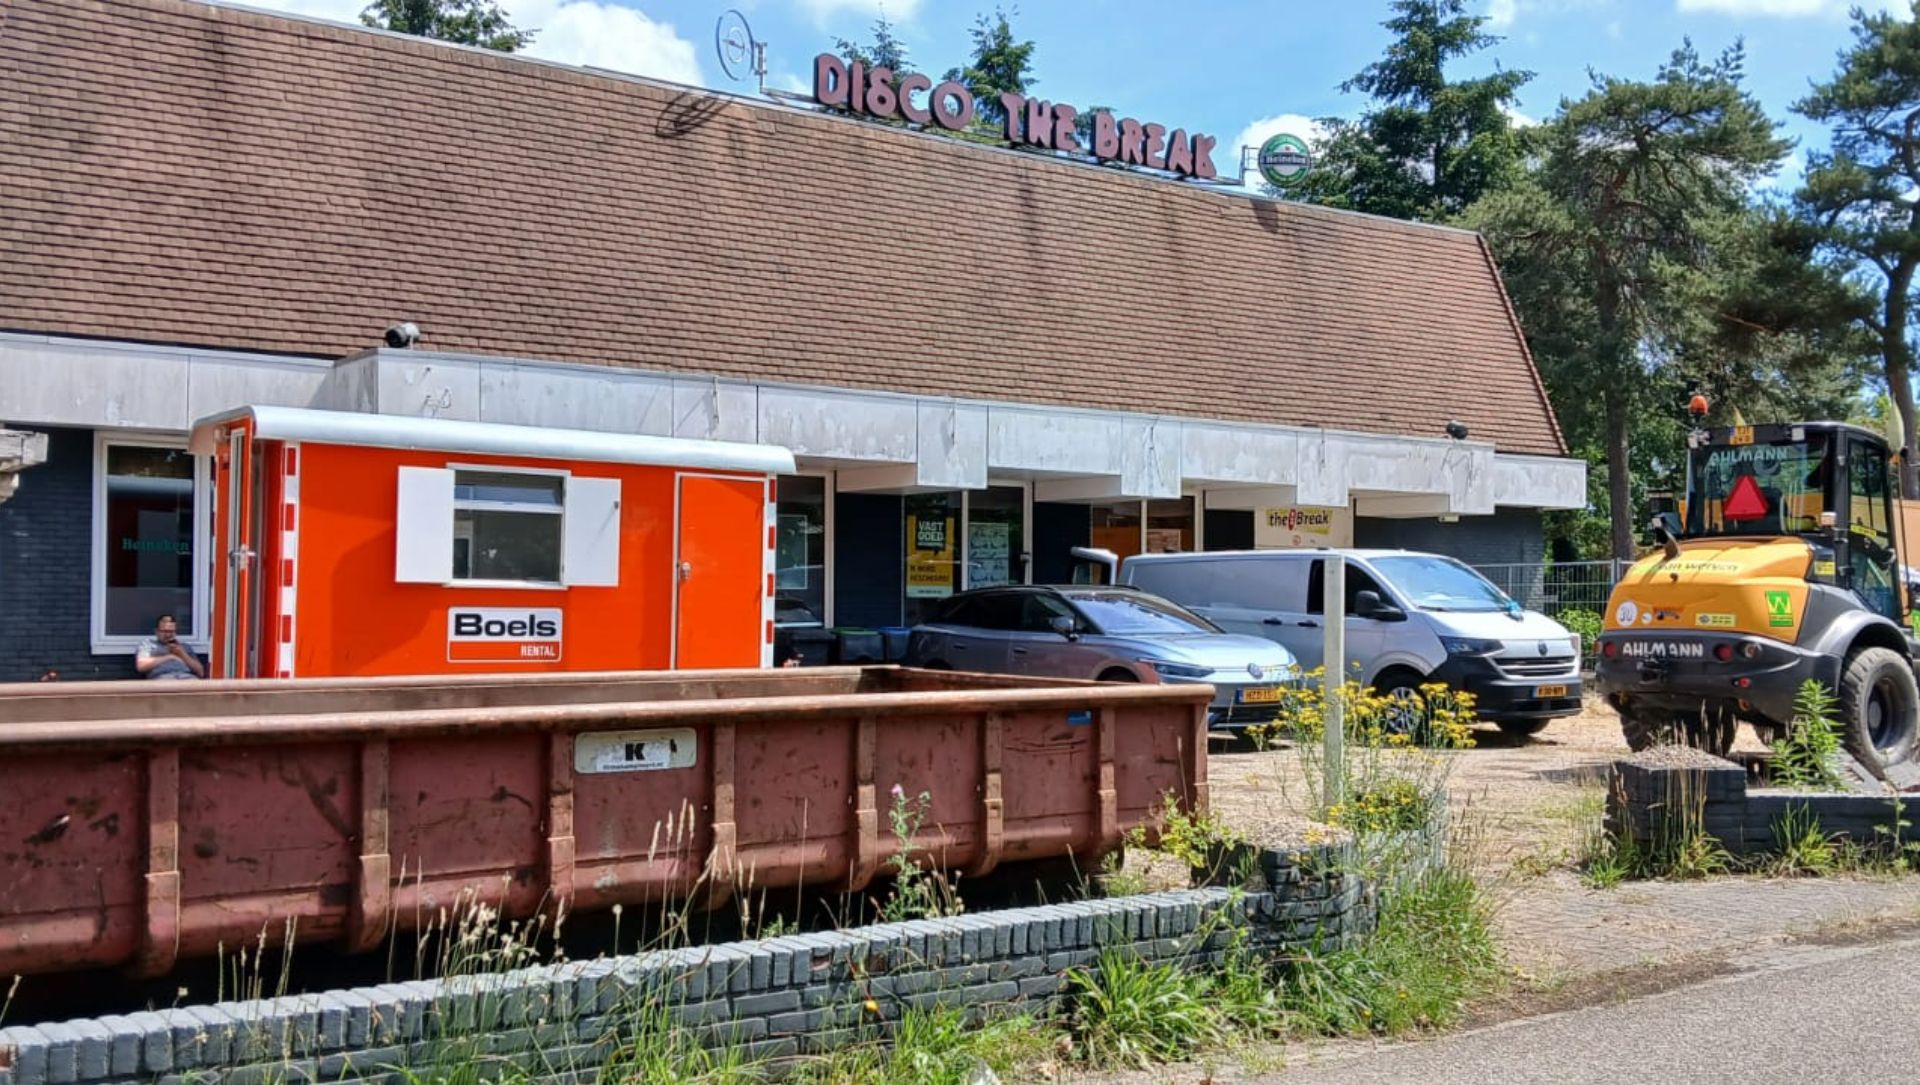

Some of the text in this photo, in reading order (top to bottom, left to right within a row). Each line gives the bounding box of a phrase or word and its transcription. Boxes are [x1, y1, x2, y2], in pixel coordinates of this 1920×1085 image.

[814, 53, 1217, 179] DISCO THE BREAK
[1705, 447, 1788, 465] AHLMANN
[1296, 509, 1329, 526] Break
[918, 521, 944, 532] VAST
[122, 537, 189, 552] Heineken
[918, 532, 944, 542] GOED
[454, 613, 557, 637] Boels
[521, 645, 556, 656] RENTAL
[1622, 641, 1704, 657] AHLMANN
[625, 743, 645, 761] K
